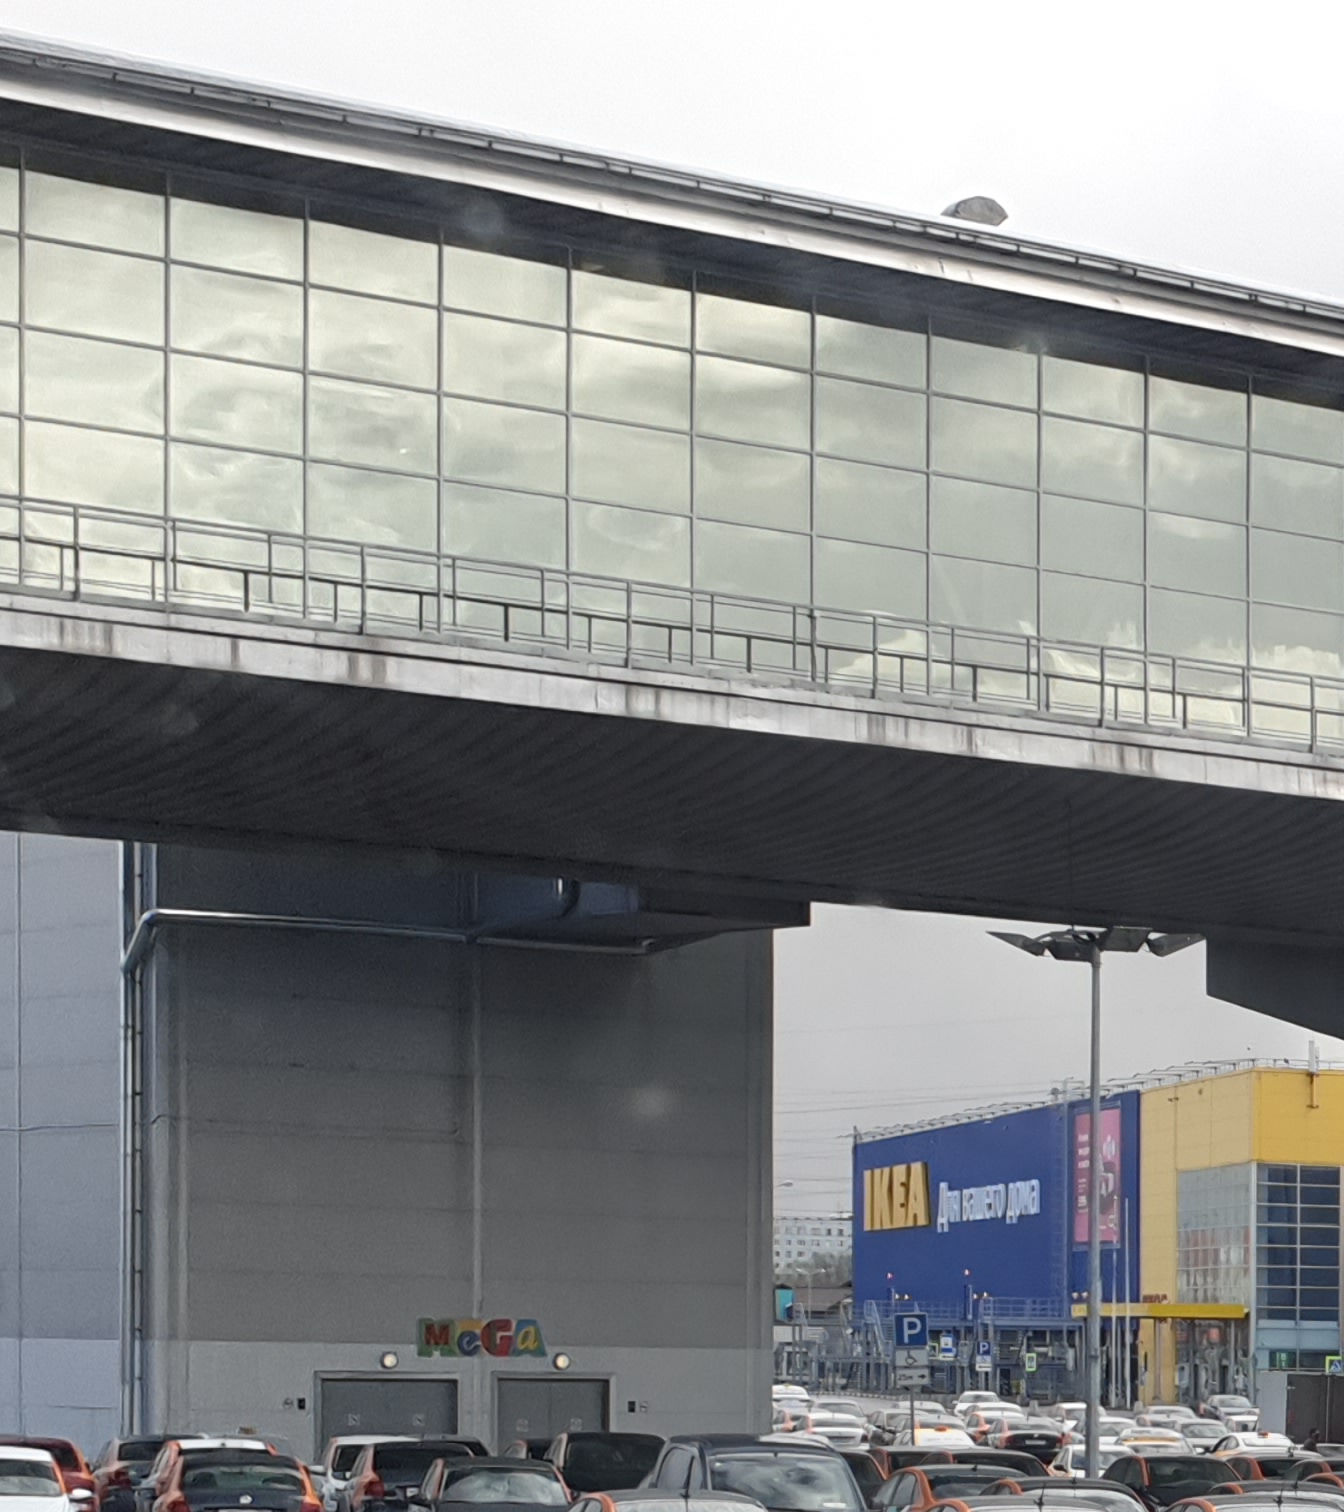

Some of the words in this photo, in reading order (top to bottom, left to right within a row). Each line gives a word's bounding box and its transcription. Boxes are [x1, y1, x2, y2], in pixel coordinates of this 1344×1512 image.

[864, 1161, 931, 1232] IKEA
[937, 1182, 961, 1233] Для
[962, 1183, 1006, 1222] вашего
[1006, 1179, 1041, 1225] дома
[902, 1317, 922, 1344] P
